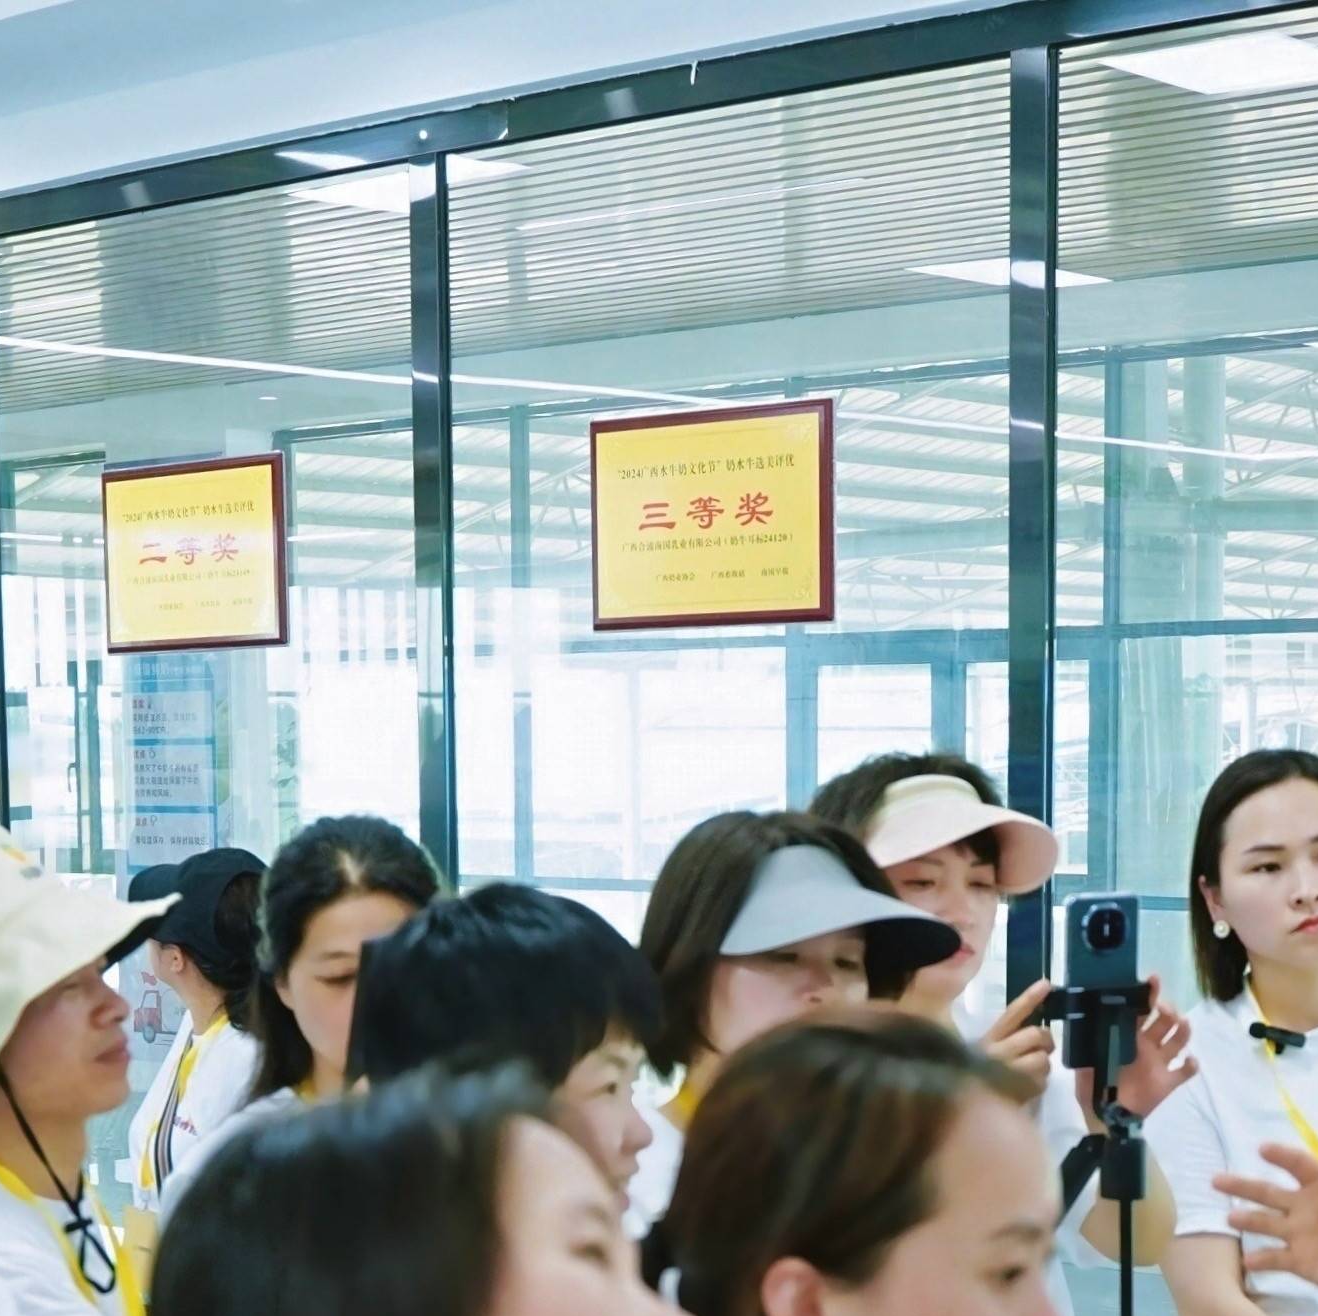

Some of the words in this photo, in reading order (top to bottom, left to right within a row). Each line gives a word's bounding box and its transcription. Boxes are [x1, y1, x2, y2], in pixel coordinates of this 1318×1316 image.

[638, 491, 774, 531] 三等奖
[138, 533, 240, 566] 二等奖
